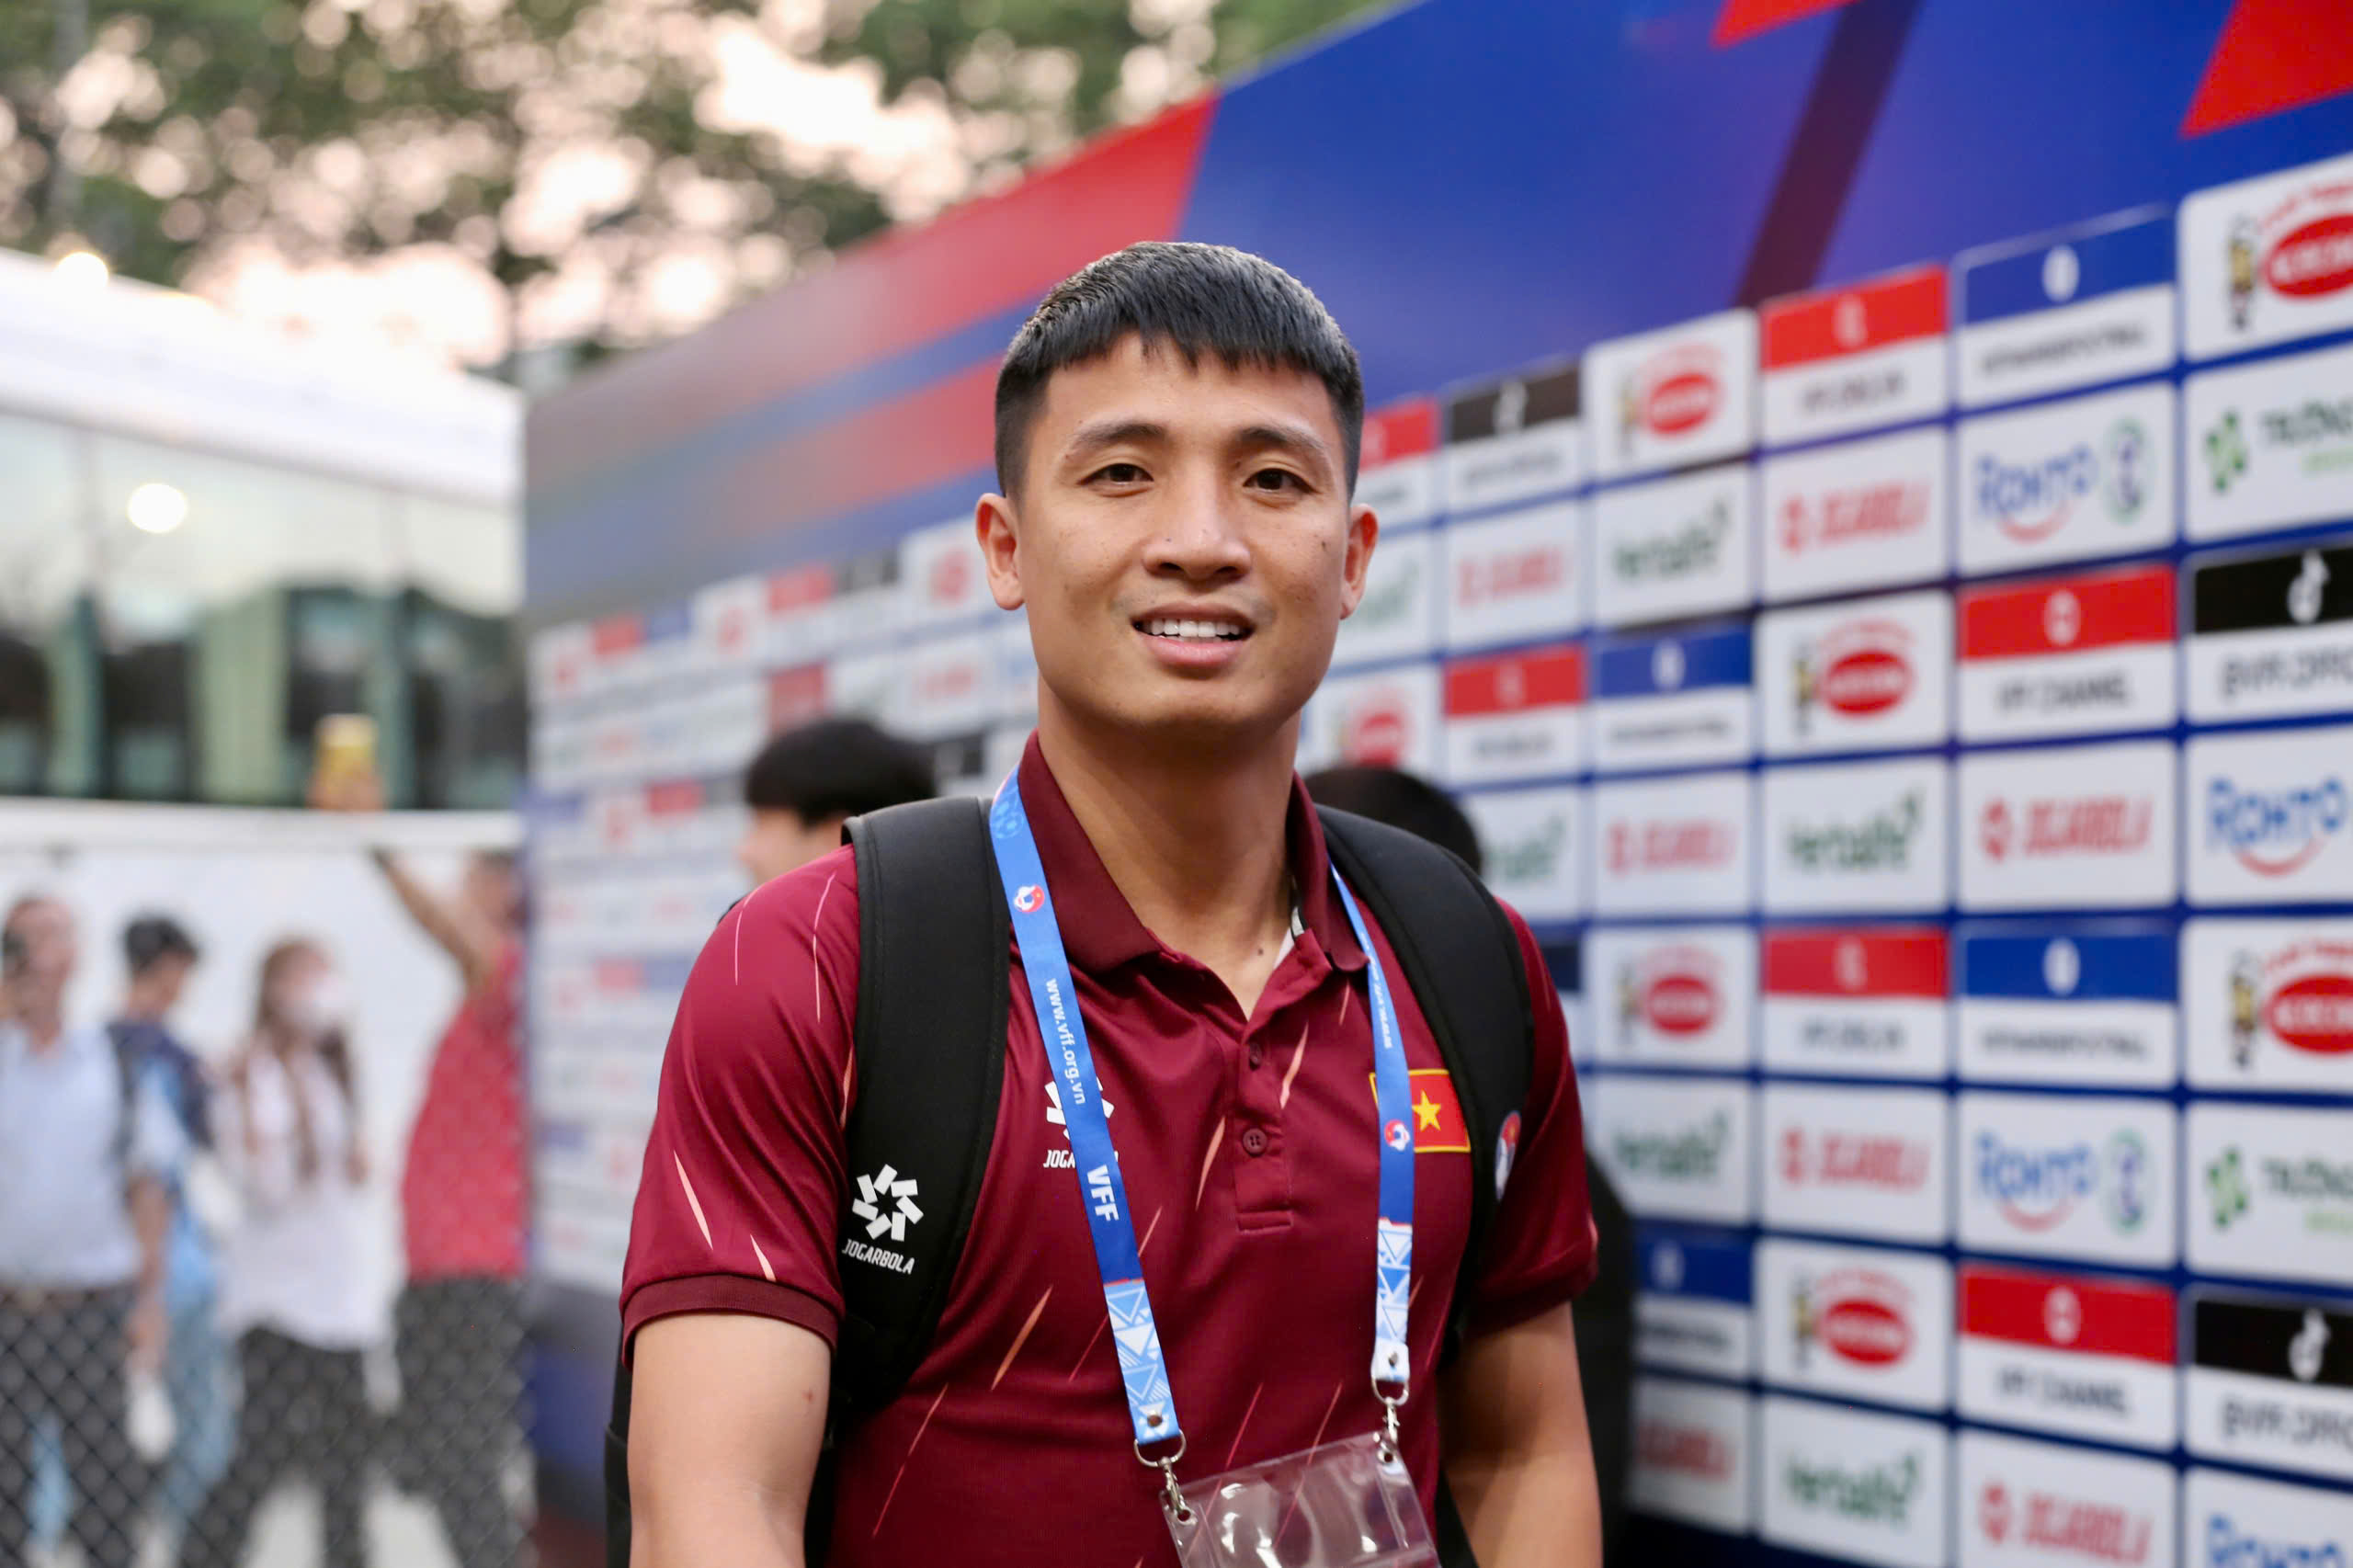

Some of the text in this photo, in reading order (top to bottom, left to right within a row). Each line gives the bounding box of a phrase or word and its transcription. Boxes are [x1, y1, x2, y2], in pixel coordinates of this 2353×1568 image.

[1045, 978, 1086, 1105] www.vff.org.vn
[1086, 1165, 1120, 1222] VFF
[841, 1238, 915, 1275] JOGARBOLA
